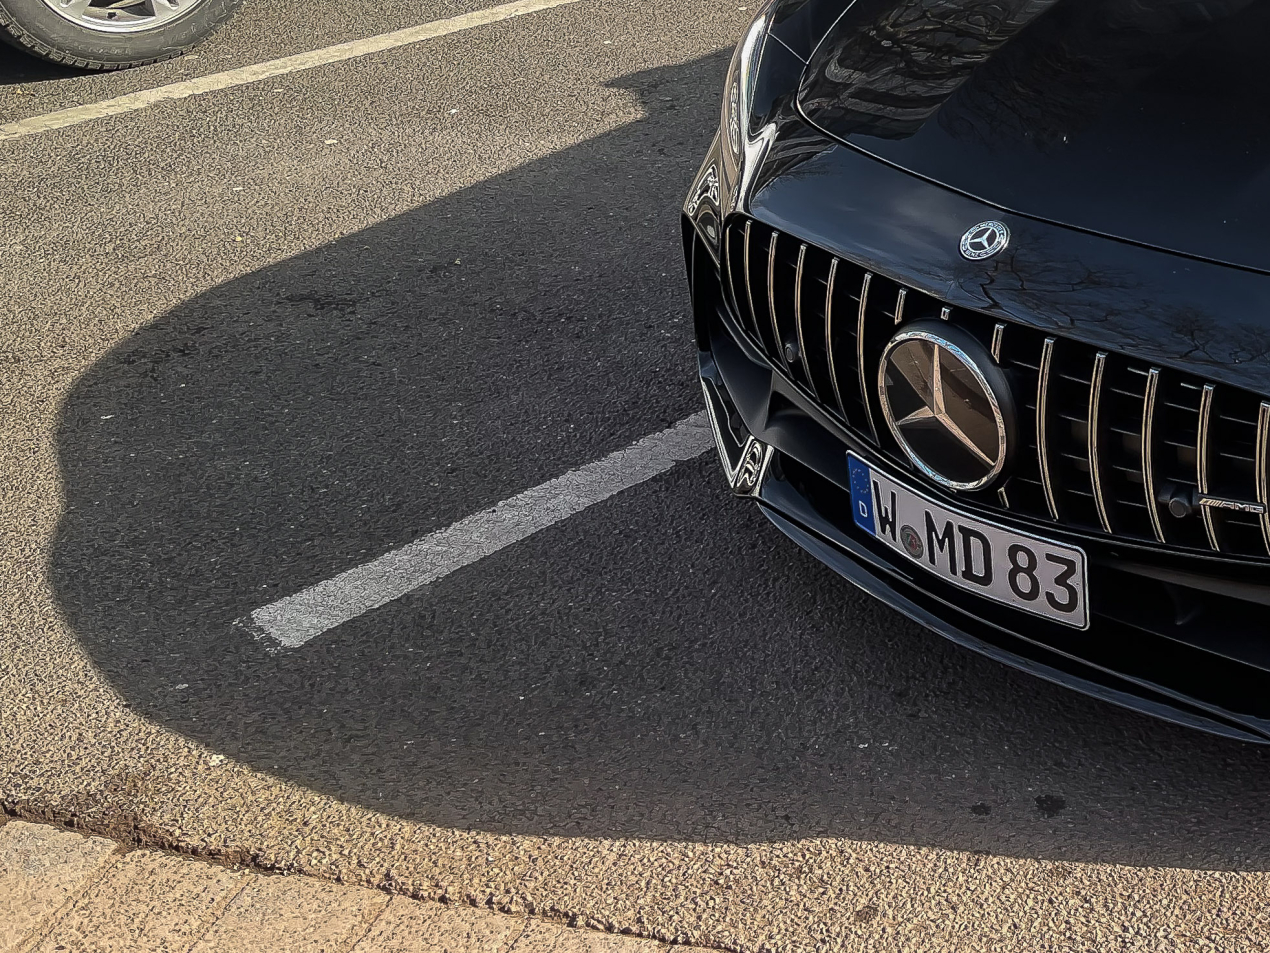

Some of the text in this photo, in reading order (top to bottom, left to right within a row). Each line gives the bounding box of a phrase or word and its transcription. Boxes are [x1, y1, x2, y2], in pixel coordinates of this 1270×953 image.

[859, 500, 868, 518] D
[873, 479, 1080, 614] W MD 83
